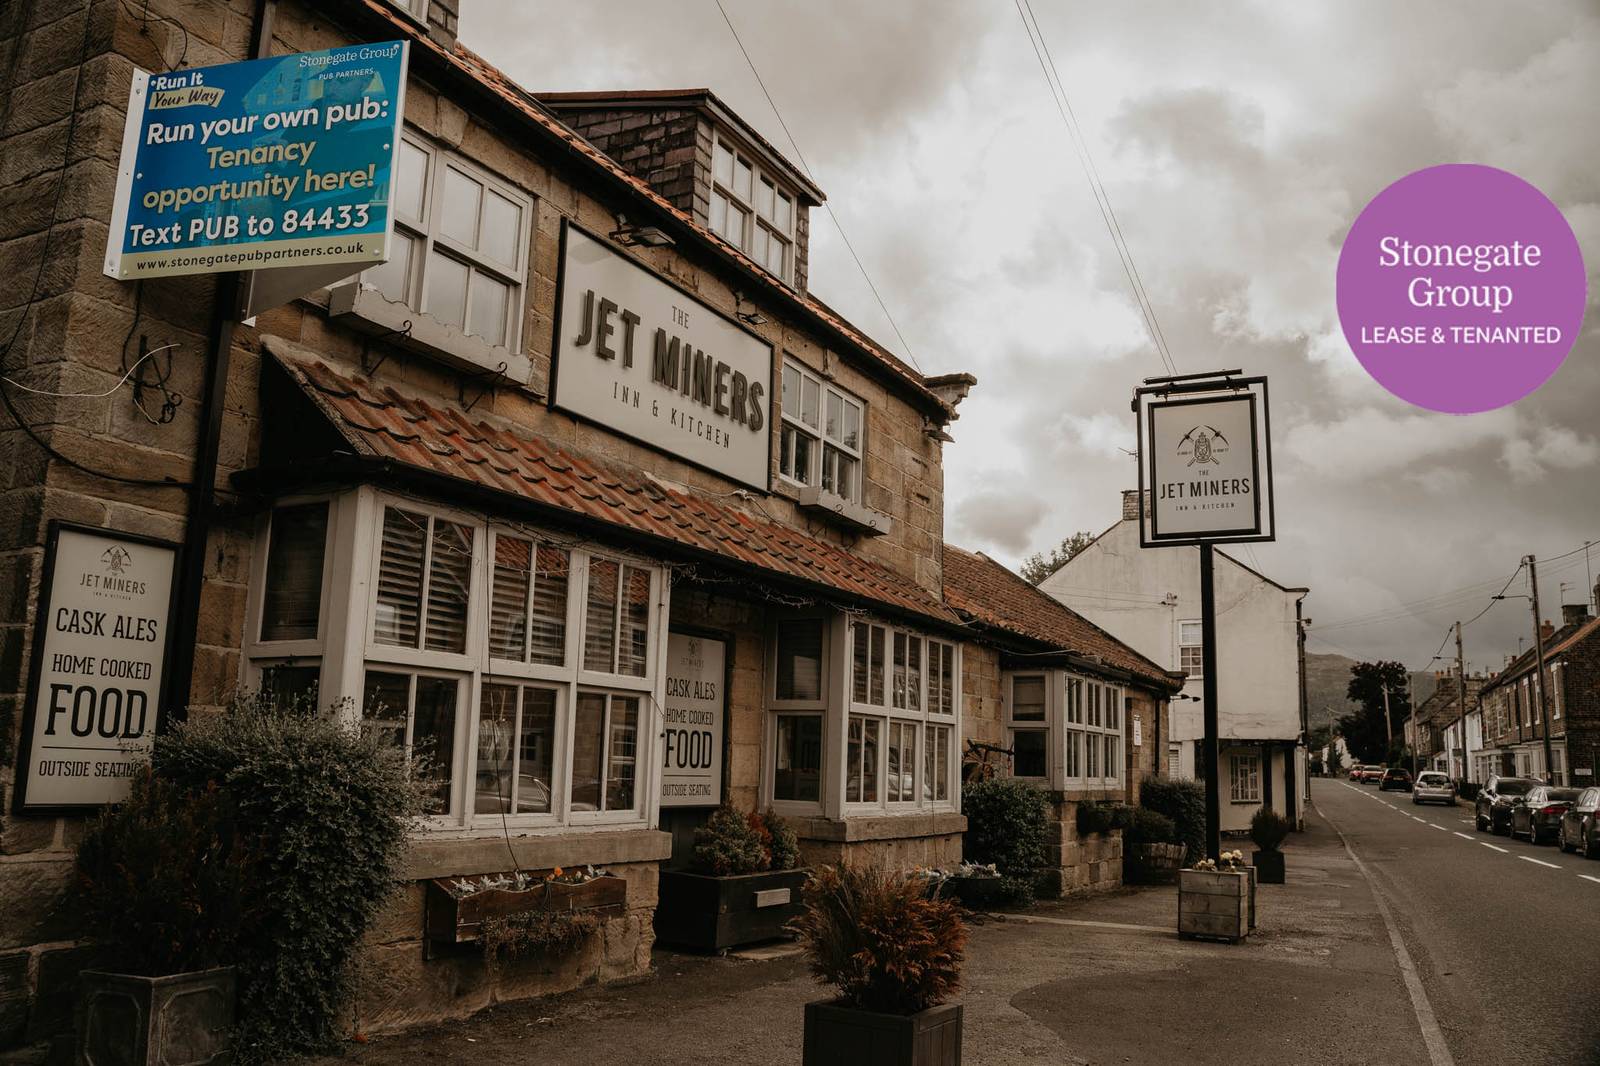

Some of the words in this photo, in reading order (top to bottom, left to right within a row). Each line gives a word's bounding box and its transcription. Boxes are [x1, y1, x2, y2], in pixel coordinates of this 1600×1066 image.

[299, 51, 357, 68] Stonegate
[359, 45, 398, 63] Group
[156, 74, 187, 91] Run
[189, 72, 203, 87] It
[318, 71, 334, 80] PUB
[336, 67, 375, 79] PARTNERS
[153, 91, 185, 108] Your
[188, 87, 219, 106] Way
[146, 122, 194, 145] Run
[201, 113, 260, 145] your
[263, 107, 318, 133] own
[325, 96, 389, 130] pub:
[207, 141, 317, 169] Tenancy
[143, 173, 298, 213] opportunity
[304, 163, 376, 192] here!
[130, 223, 181, 247] Text
[189, 215, 239, 241] PUB
[248, 214, 274, 236] to
[282, 203, 370, 233] 84433
[136, 242, 364, 270] www.stonegatepubpartners.co.uk
[672, 305, 689, 329] THE
[576, 289, 641, 369] JET
[652, 327, 764, 432] MINERS
[613, 381, 640, 409] INN
[652, 400, 659, 417] &
[671, 407, 729, 449] KITCHEN
[1160, 482, 1185, 499] JET
[1190, 478, 1250, 497] MINERS
[80, 573, 100, 588] JET
[103, 576, 146, 595] MINERS
[56, 607, 107, 637] CASK
[112, 615, 158, 642] ALES
[52, 653, 96, 676] HOME
[100, 658, 152, 680] COOKED
[666, 677, 691, 699] CASK
[694, 680, 715, 701] ALES
[44, 683, 148, 739] FOOD
[666, 708, 687, 723] HOME
[689, 710, 714, 725] COOKED
[664, 729, 713, 769] FOOD
[39, 760, 91, 777] OUTSIDE
[663, 784, 687, 797] OUTSIDE
[688, 784, 711, 796] SEATING
